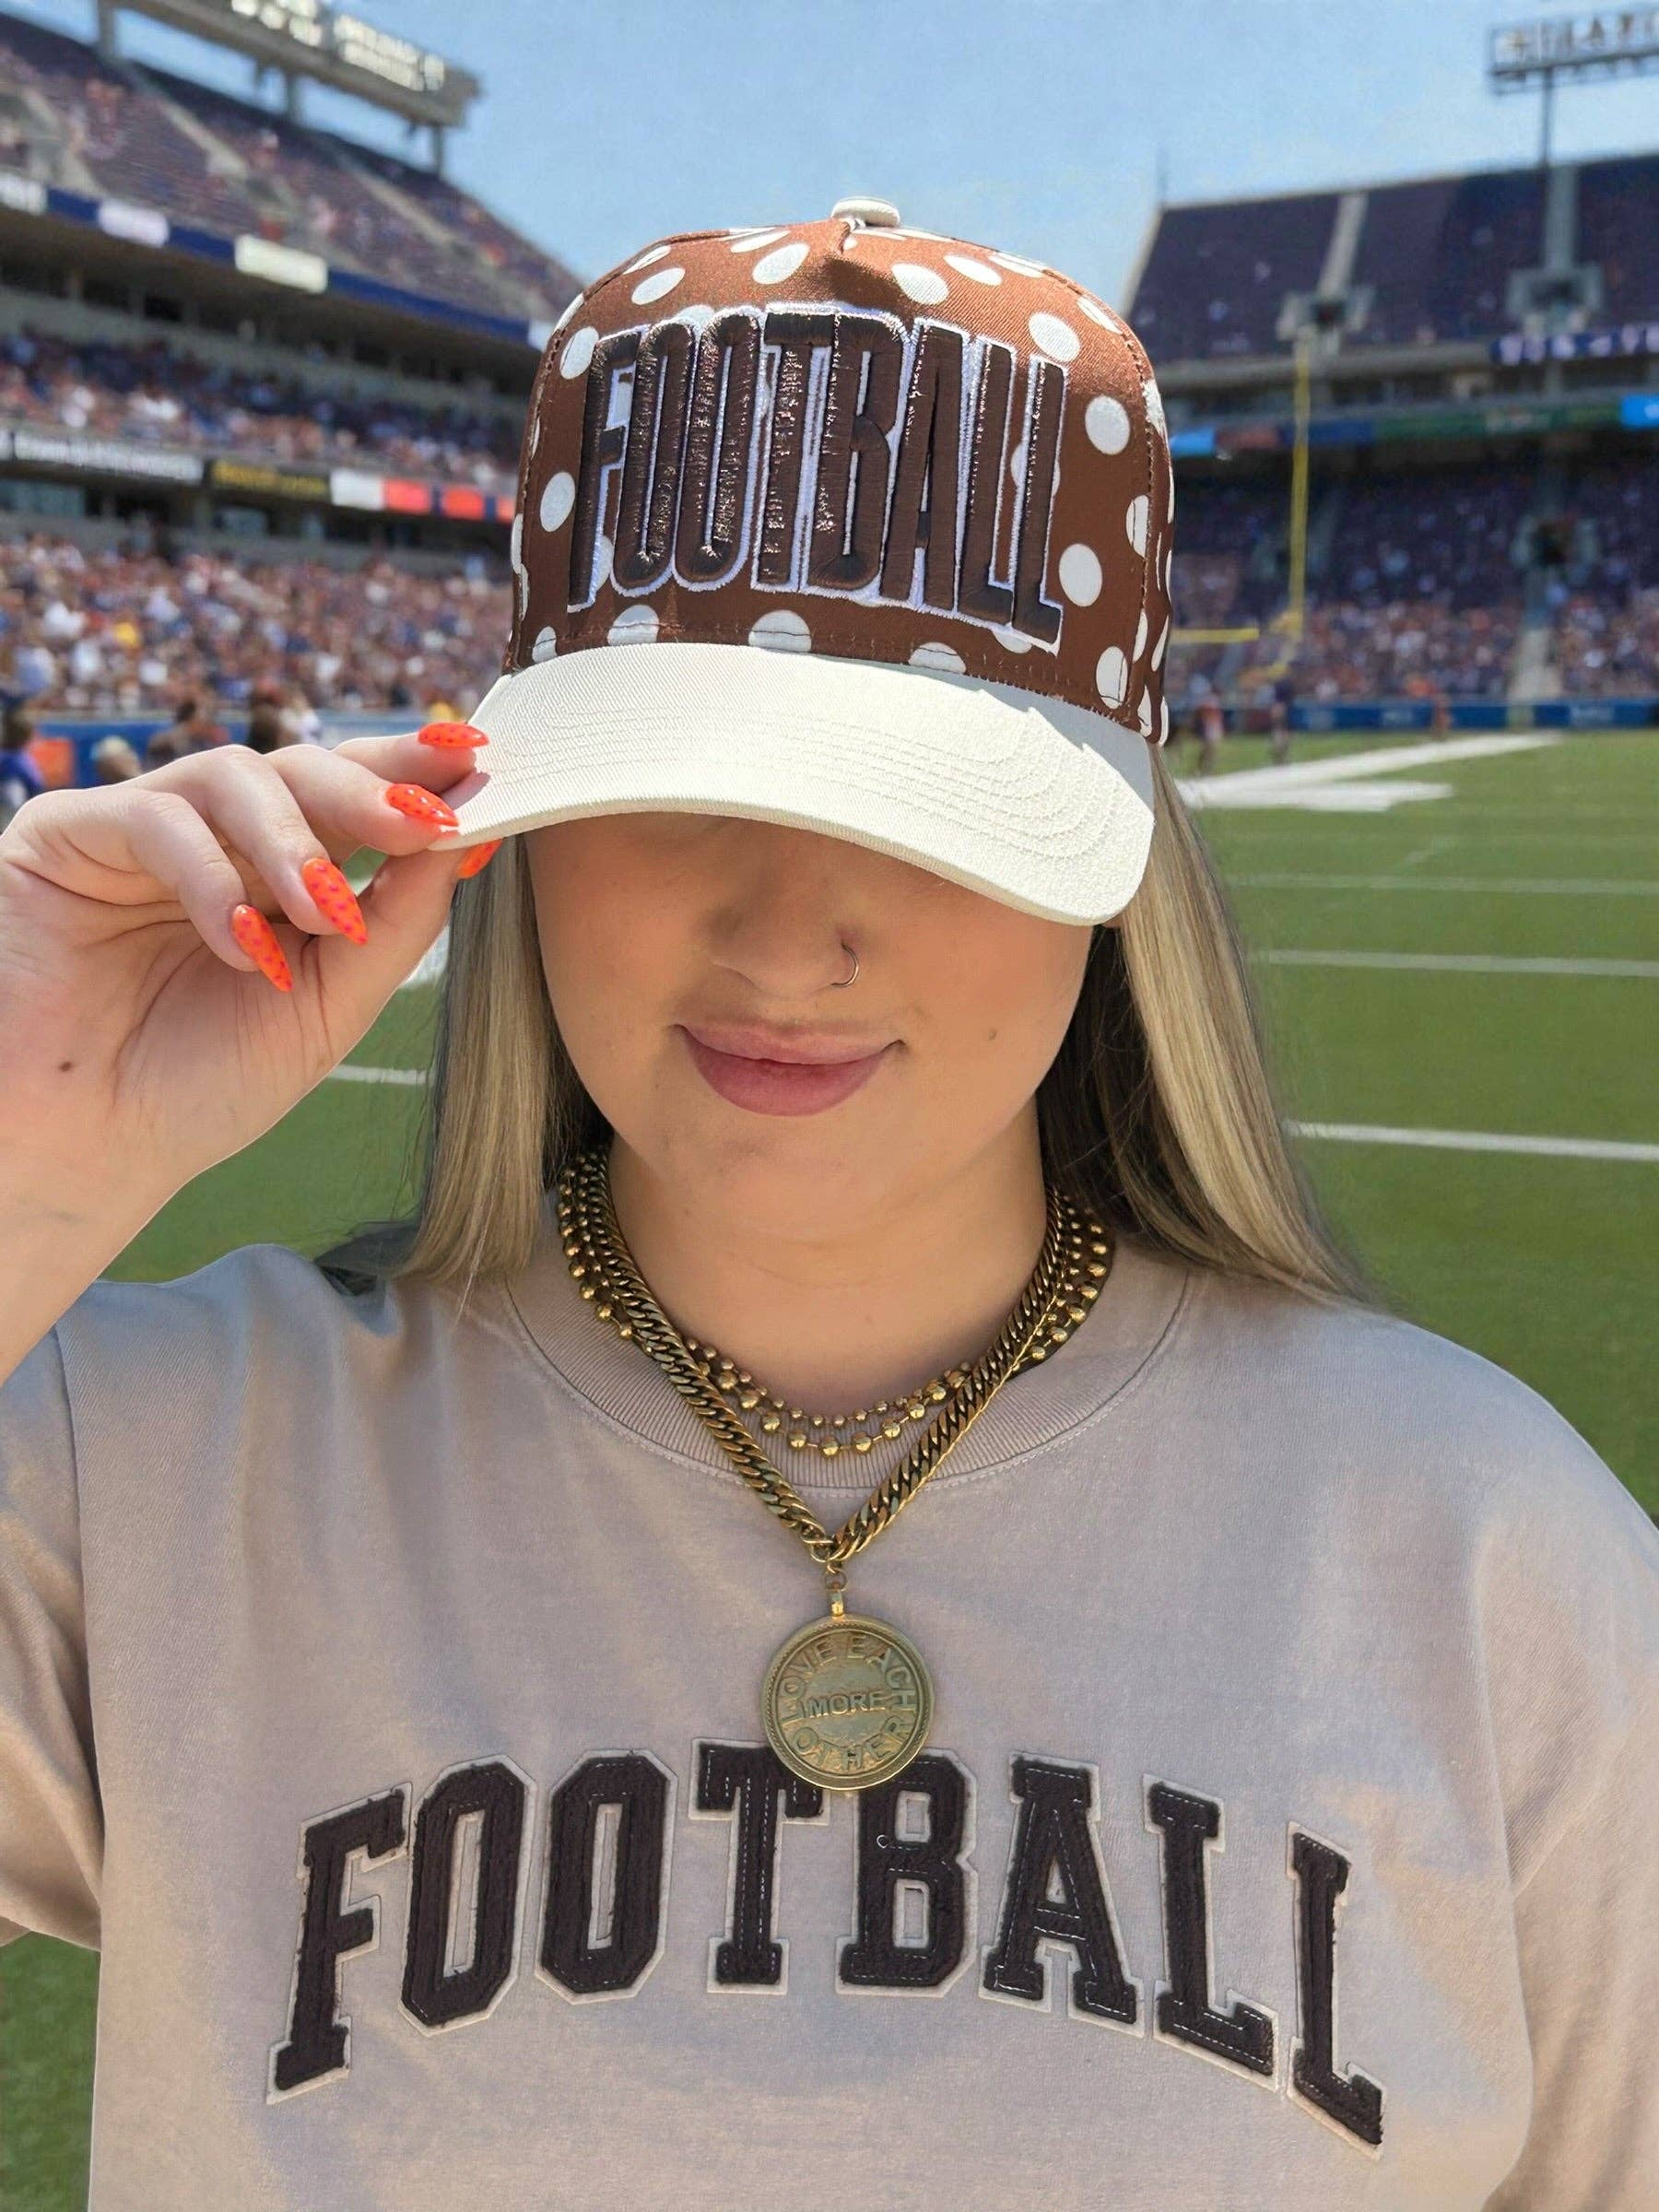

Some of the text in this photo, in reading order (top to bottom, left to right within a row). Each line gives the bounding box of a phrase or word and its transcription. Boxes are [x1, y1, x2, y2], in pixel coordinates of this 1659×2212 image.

[567, 302, 1069, 655] FOOTBALL
[781, 1634, 917, 1726] LOVE EACH
[806, 1690, 887, 1719] MORE
[792, 1715, 913, 1771] OTHER
[265, 1736, 1386, 2161] FOOTBALL
